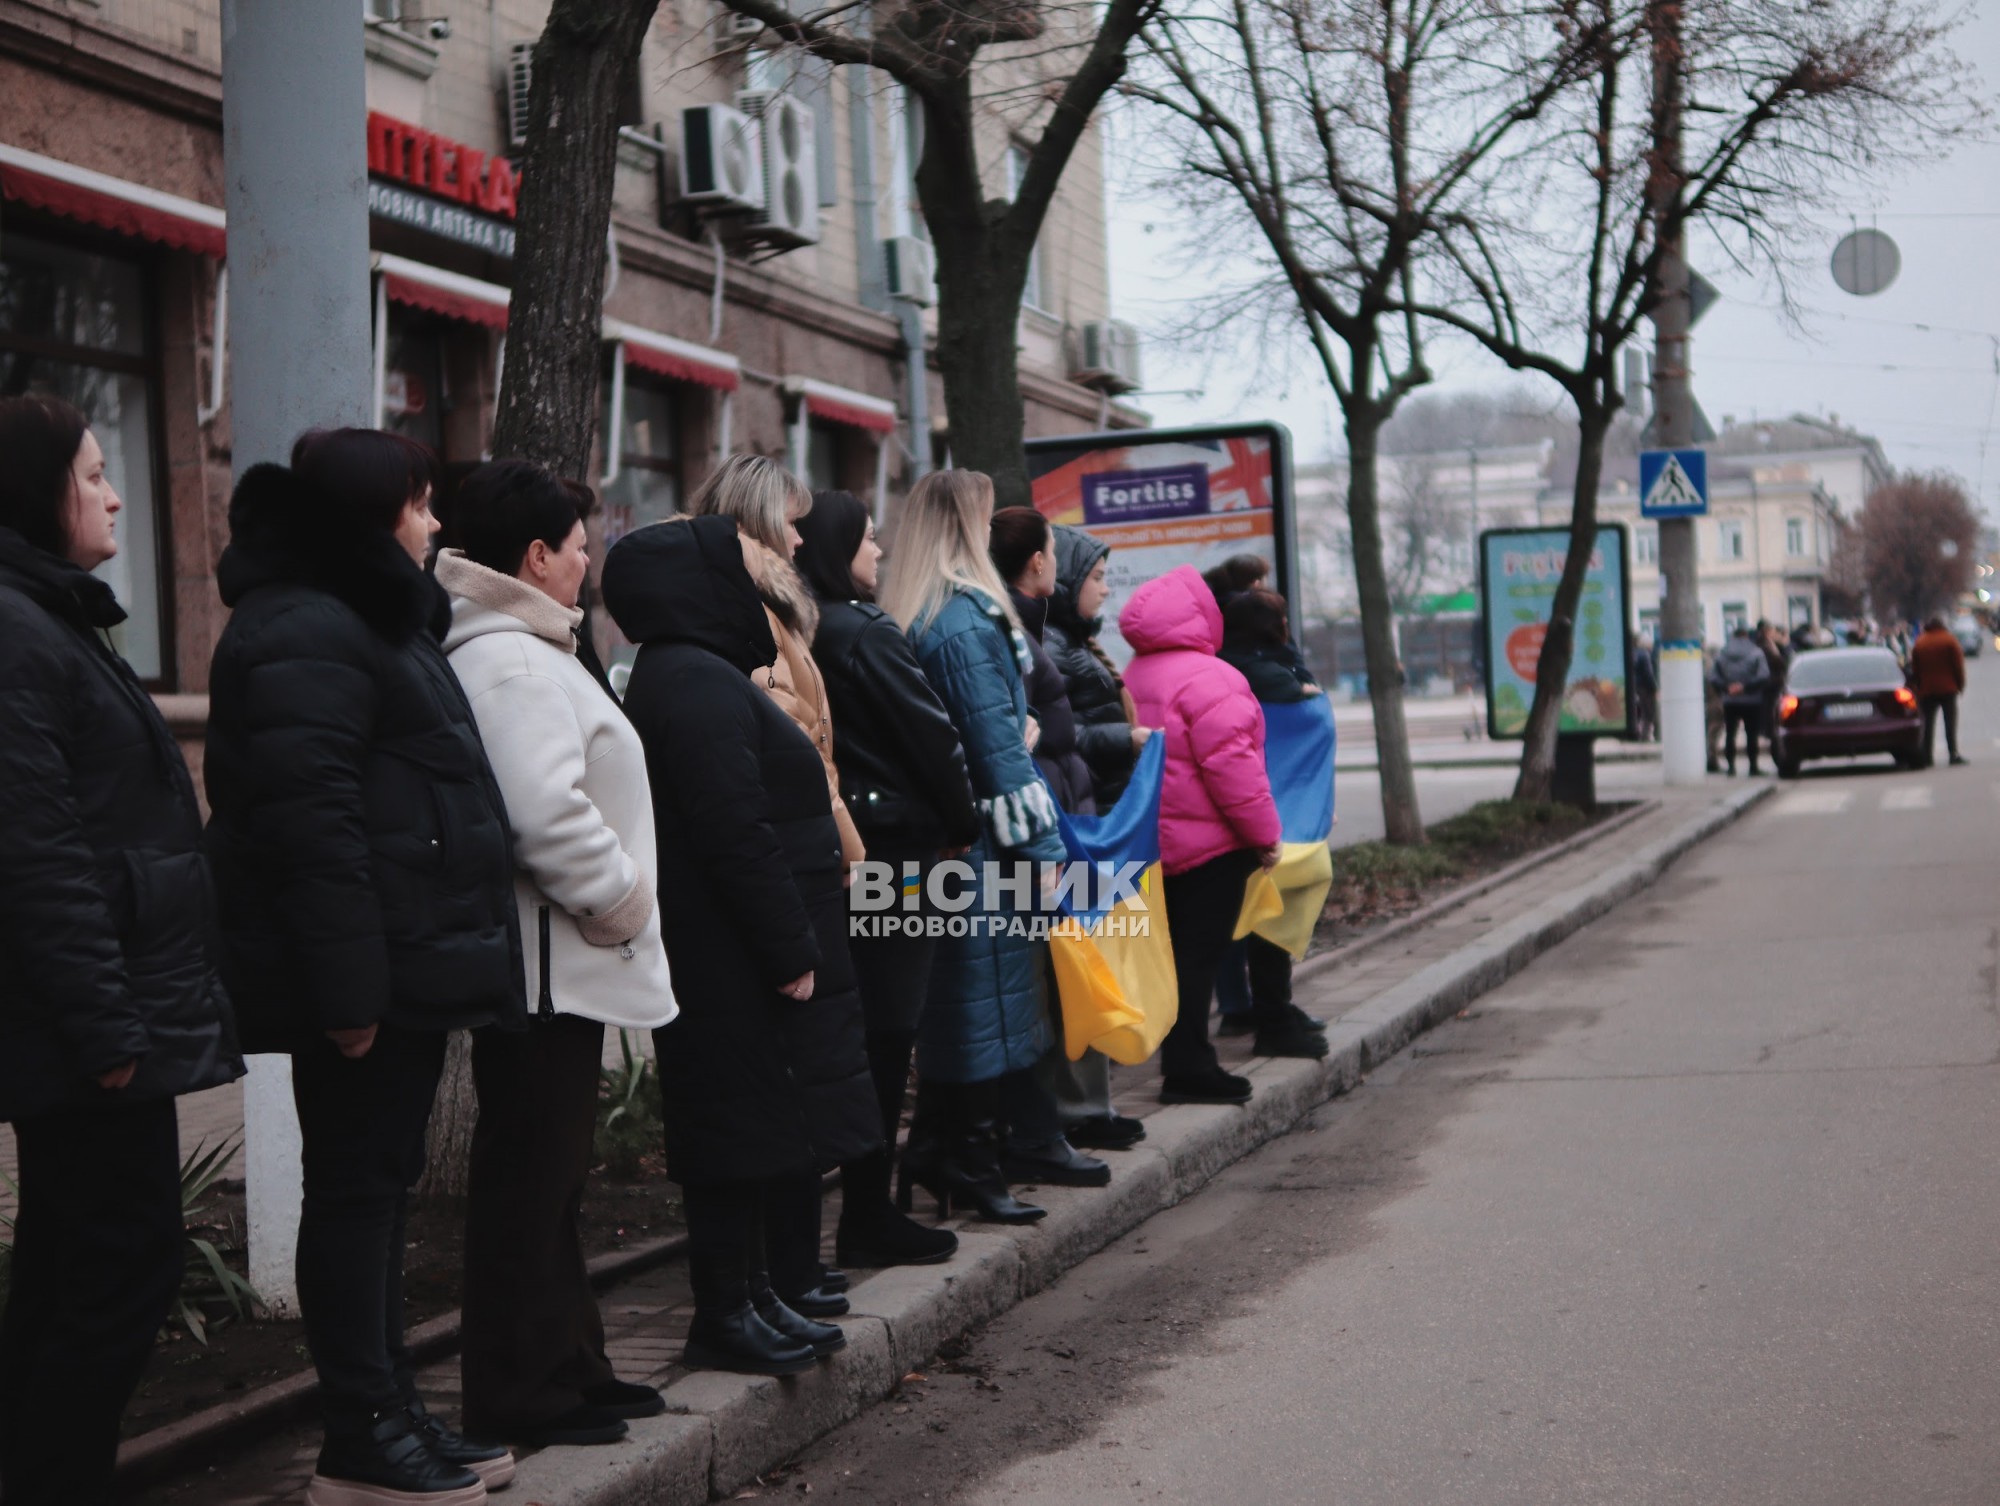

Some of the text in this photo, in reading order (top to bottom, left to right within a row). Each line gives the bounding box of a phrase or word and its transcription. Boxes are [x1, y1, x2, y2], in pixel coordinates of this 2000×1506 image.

[367, 111, 518, 219] ПТЕКА
[369, 184, 427, 224] ЛОВНА
[431, 206, 495, 248] АПТЕКА
[1095, 480, 1196, 507] Fortiss
